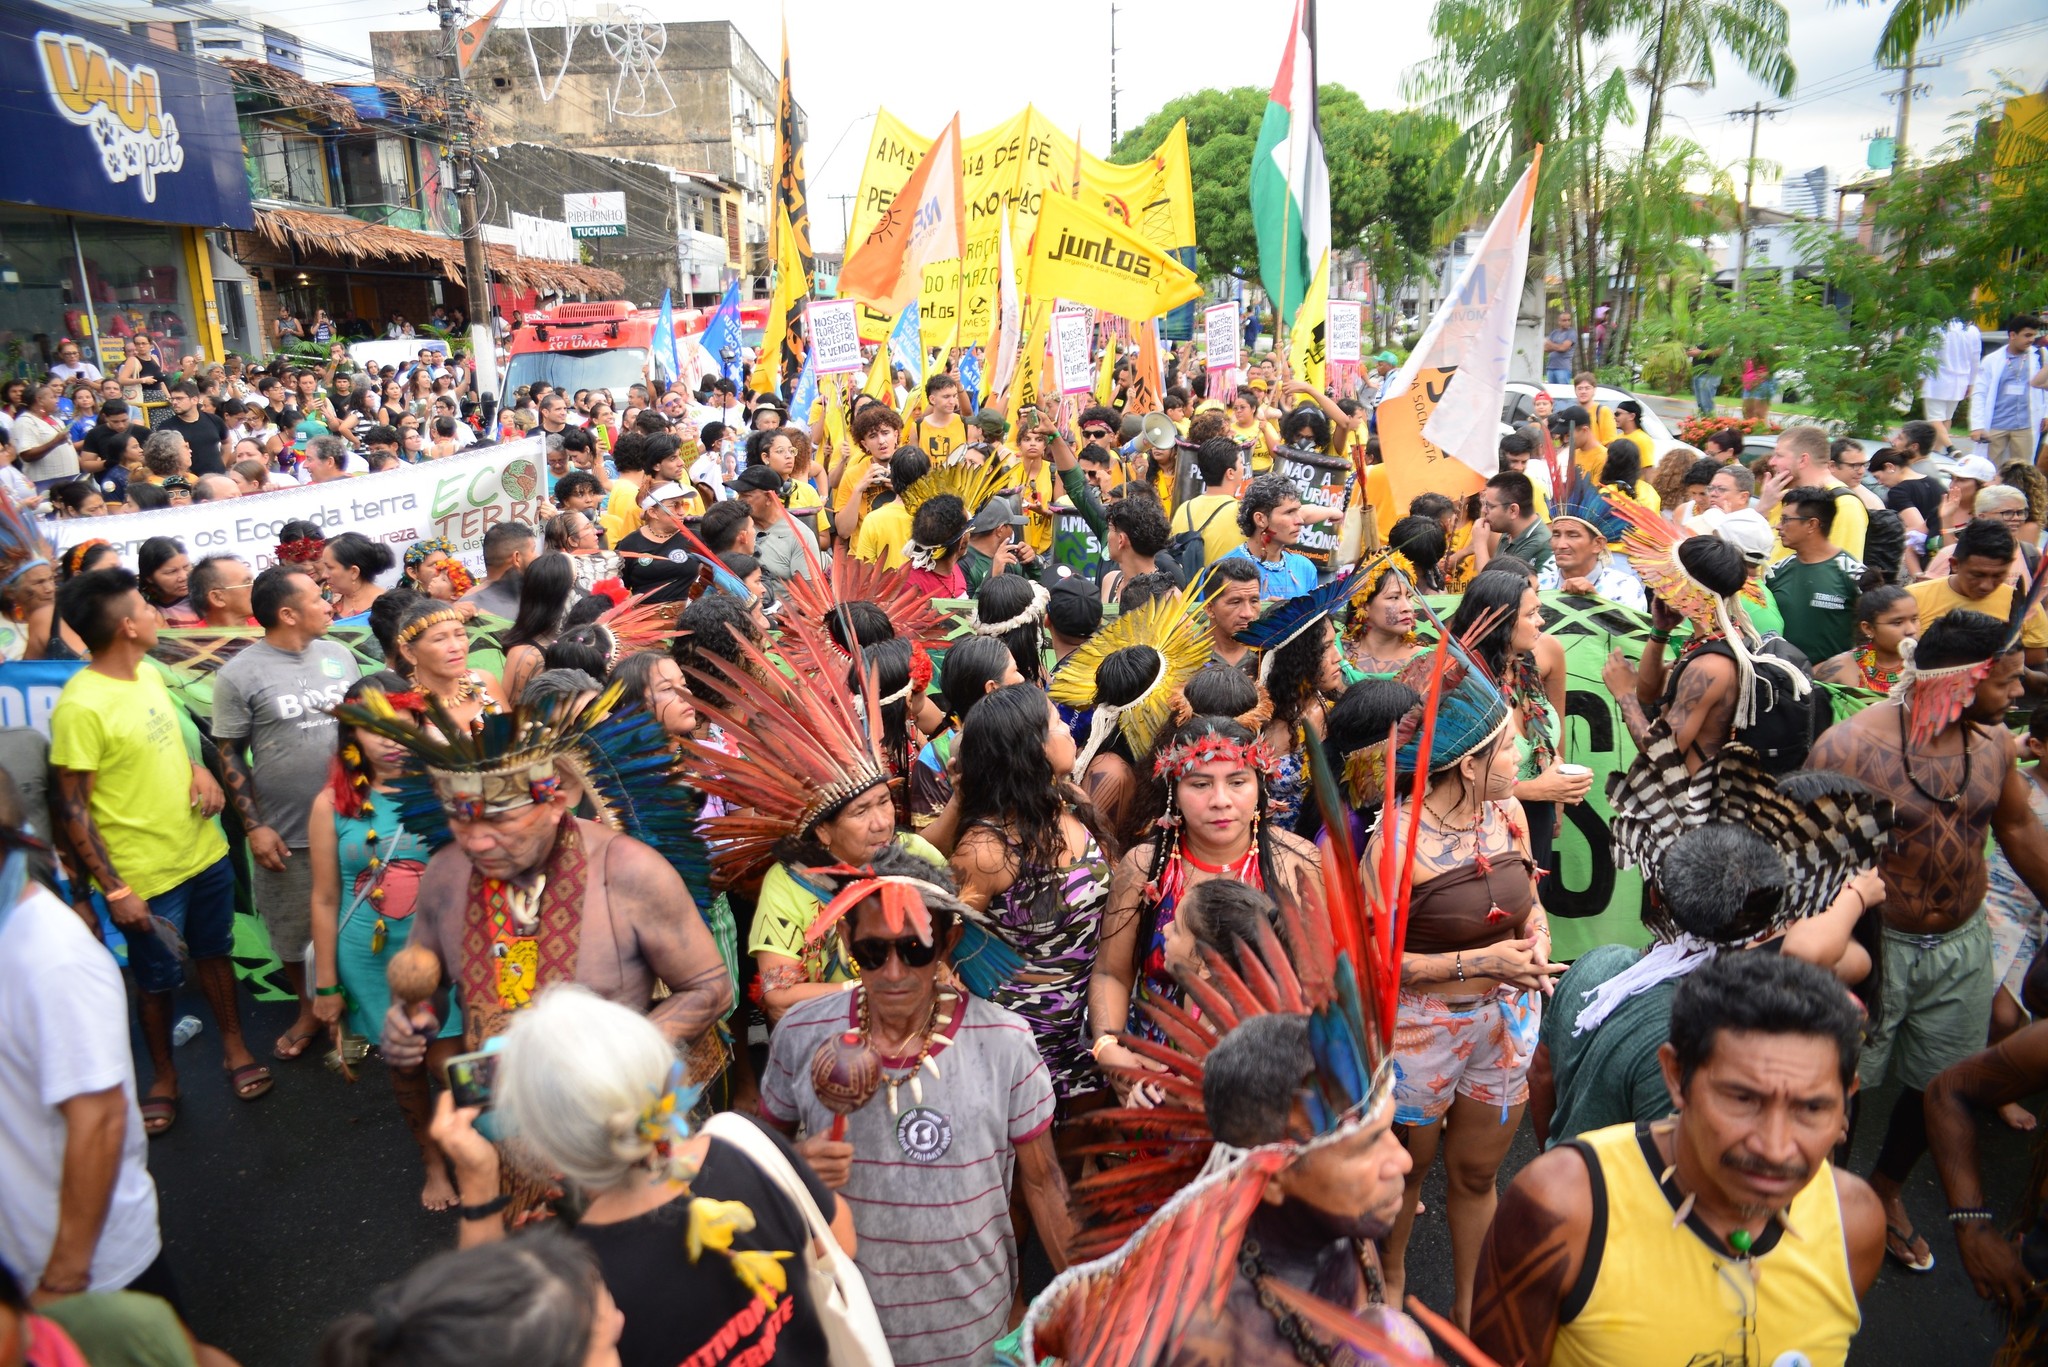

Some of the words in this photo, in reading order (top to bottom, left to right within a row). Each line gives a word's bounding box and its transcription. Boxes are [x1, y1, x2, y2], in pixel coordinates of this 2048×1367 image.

[43, 39, 162, 139] UAU!
[143, 119, 182, 196] pet
[994, 136, 1021, 168] DE
[1027, 133, 1052, 167] PÉ
[567, 209, 624, 223] RIBEIRINHO
[972, 192, 999, 221] NO
[575, 226, 619, 238] TUCHAUA
[1048, 227, 1151, 278] juntos
[925, 275, 944, 294] DO
[1064, 257, 1094, 271] organize
[1096, 265, 1109, 273] sua
[1110, 269, 1149, 286] indignação
[814, 312, 851, 328] NOSSAS
[828, 343, 857, 357] VENDA
[1283, 459, 1316, 481] NÃO
[1321, 472, 1332, 486] A
[194, 529, 228, 547] os
[309, 505, 343, 529] da
[350, 491, 419, 522] terra
